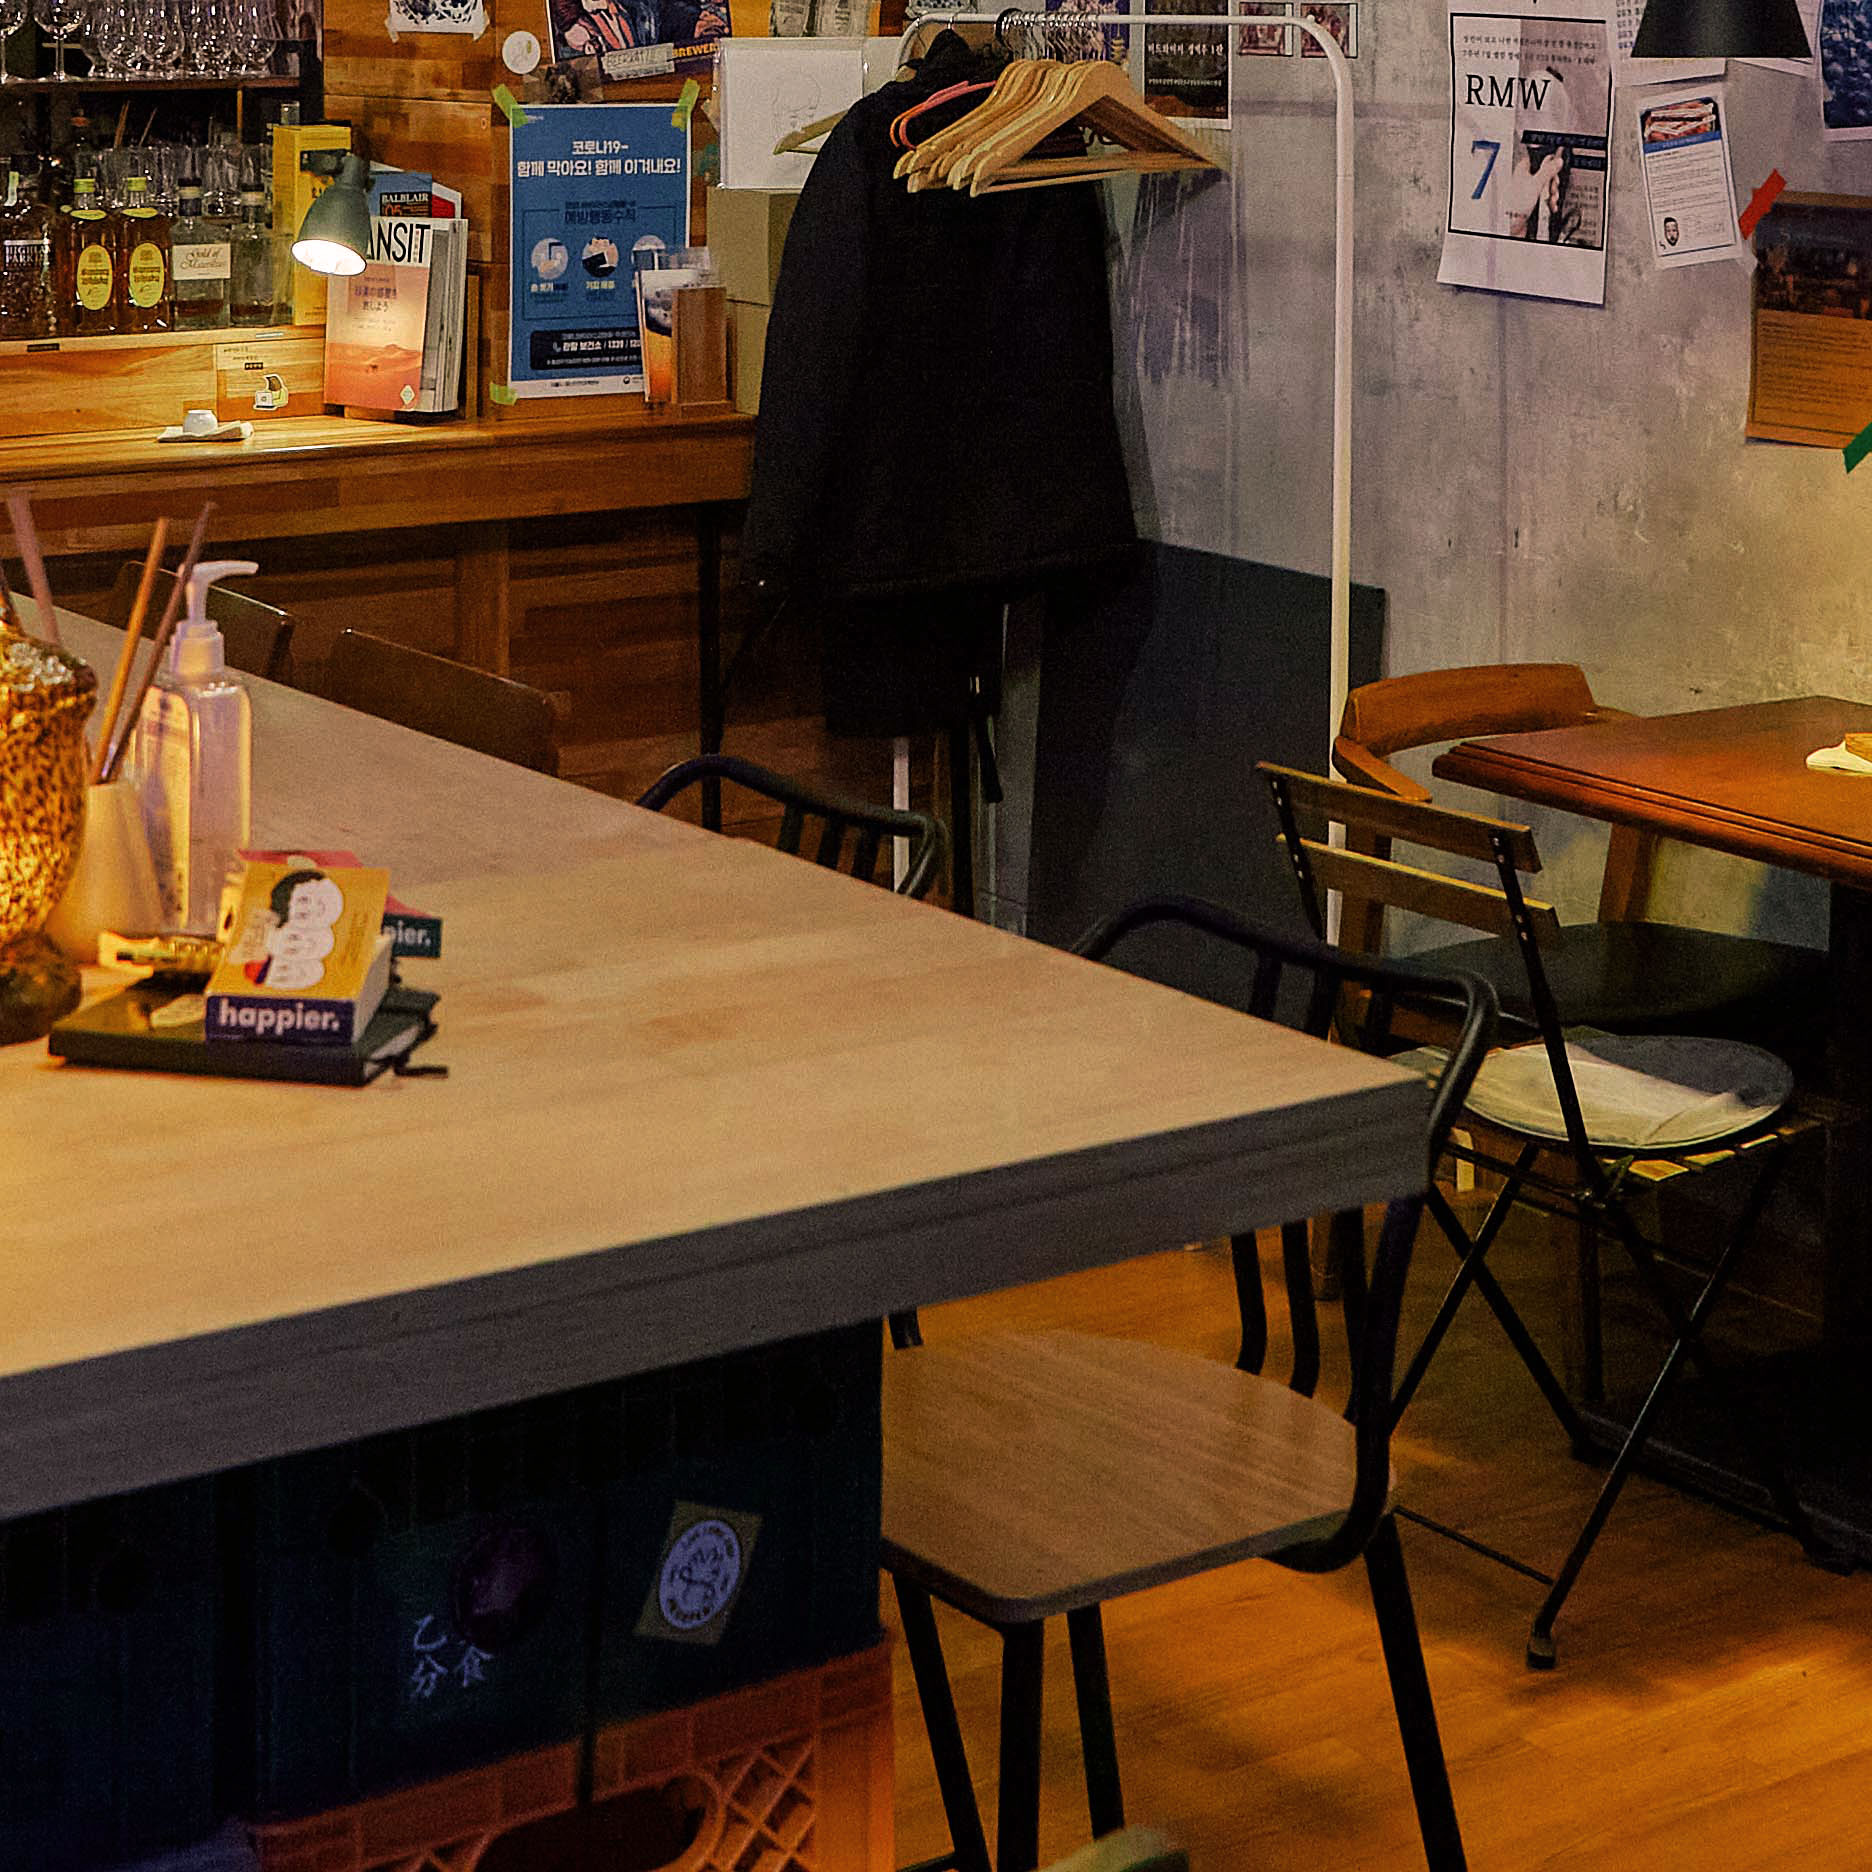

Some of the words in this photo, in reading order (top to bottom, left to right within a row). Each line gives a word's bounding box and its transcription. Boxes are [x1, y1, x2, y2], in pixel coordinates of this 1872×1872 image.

[1465, 73, 1551, 111] RMW
[547, 160, 593, 177] 막아요!
[595, 160, 622, 176] 함께
[625, 157, 682, 175] 이겨내요!
[1470, 139, 1502, 200] 7
[382, 192, 430, 204] BALBLAIR
[217, 999, 341, 1035] happier.
